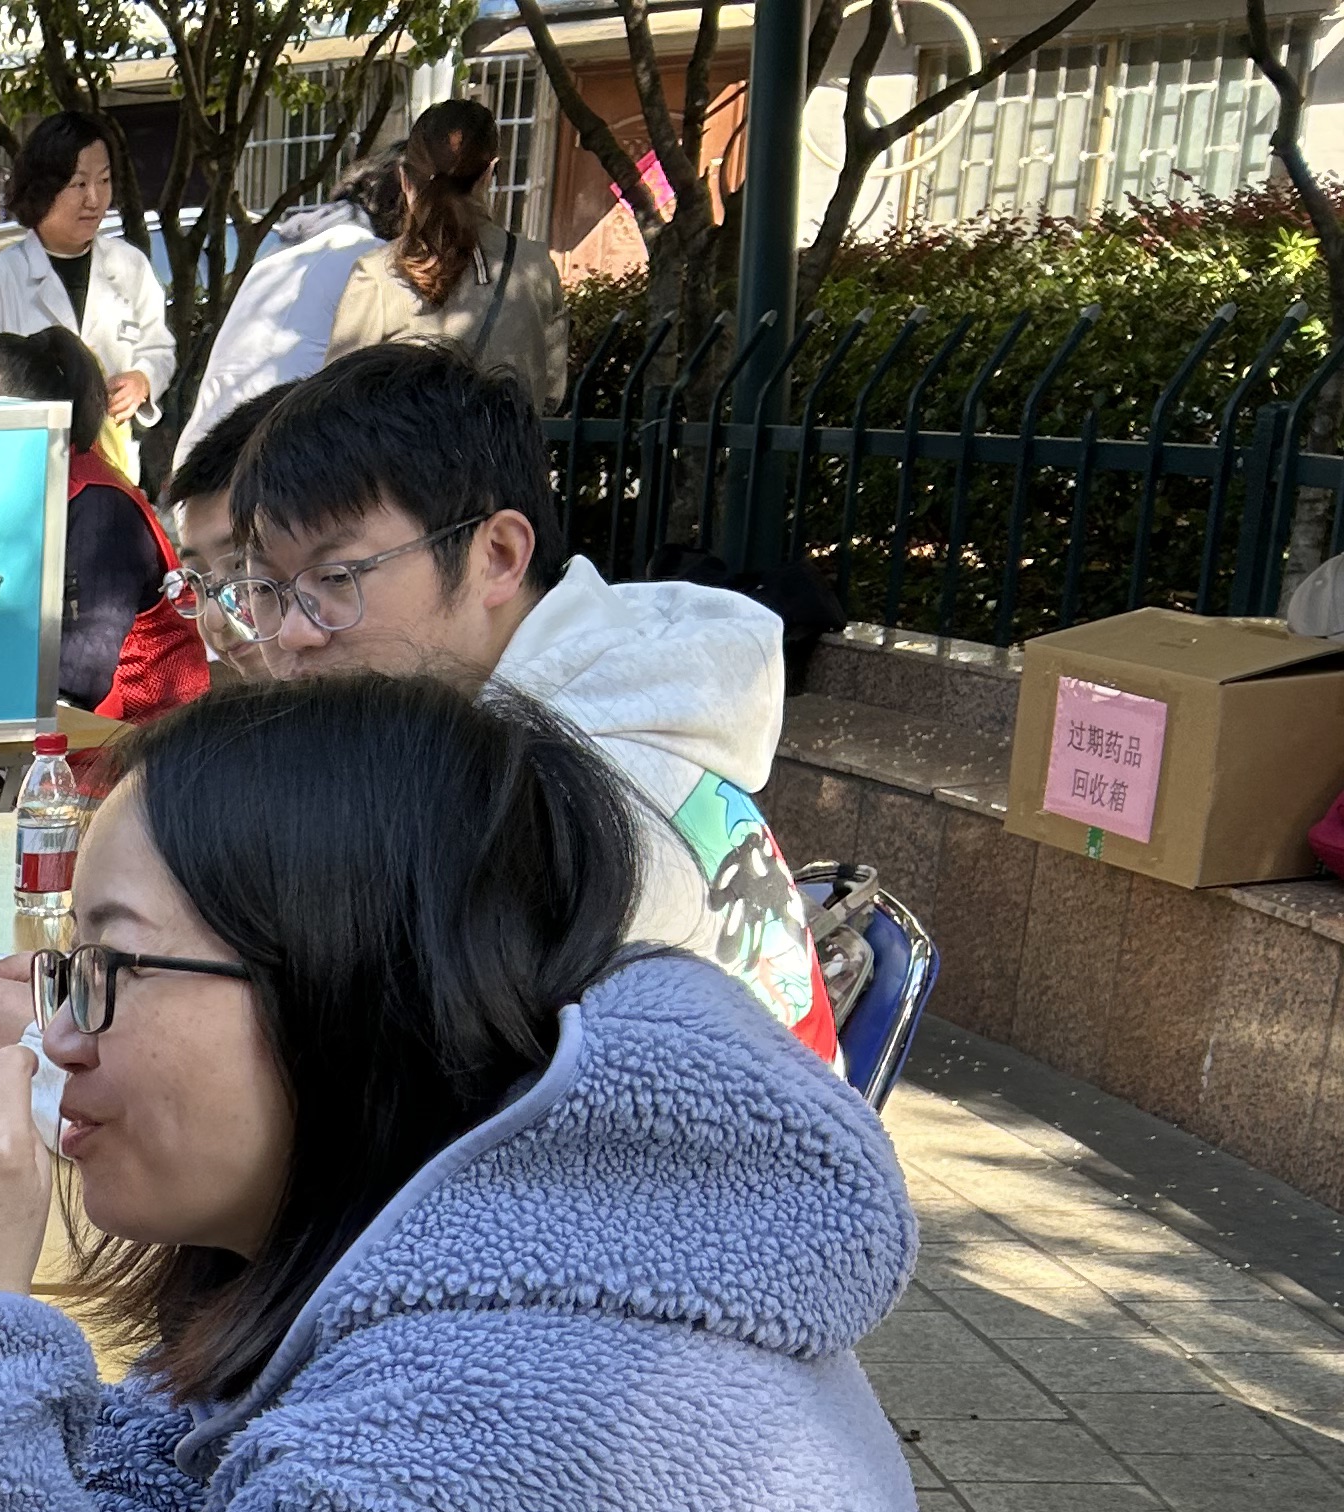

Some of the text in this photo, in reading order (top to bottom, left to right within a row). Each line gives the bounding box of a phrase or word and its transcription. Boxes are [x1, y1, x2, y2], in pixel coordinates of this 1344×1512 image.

[1066, 720, 1143, 769] 过期药品
[1071, 767, 1130, 813] 回收箱
